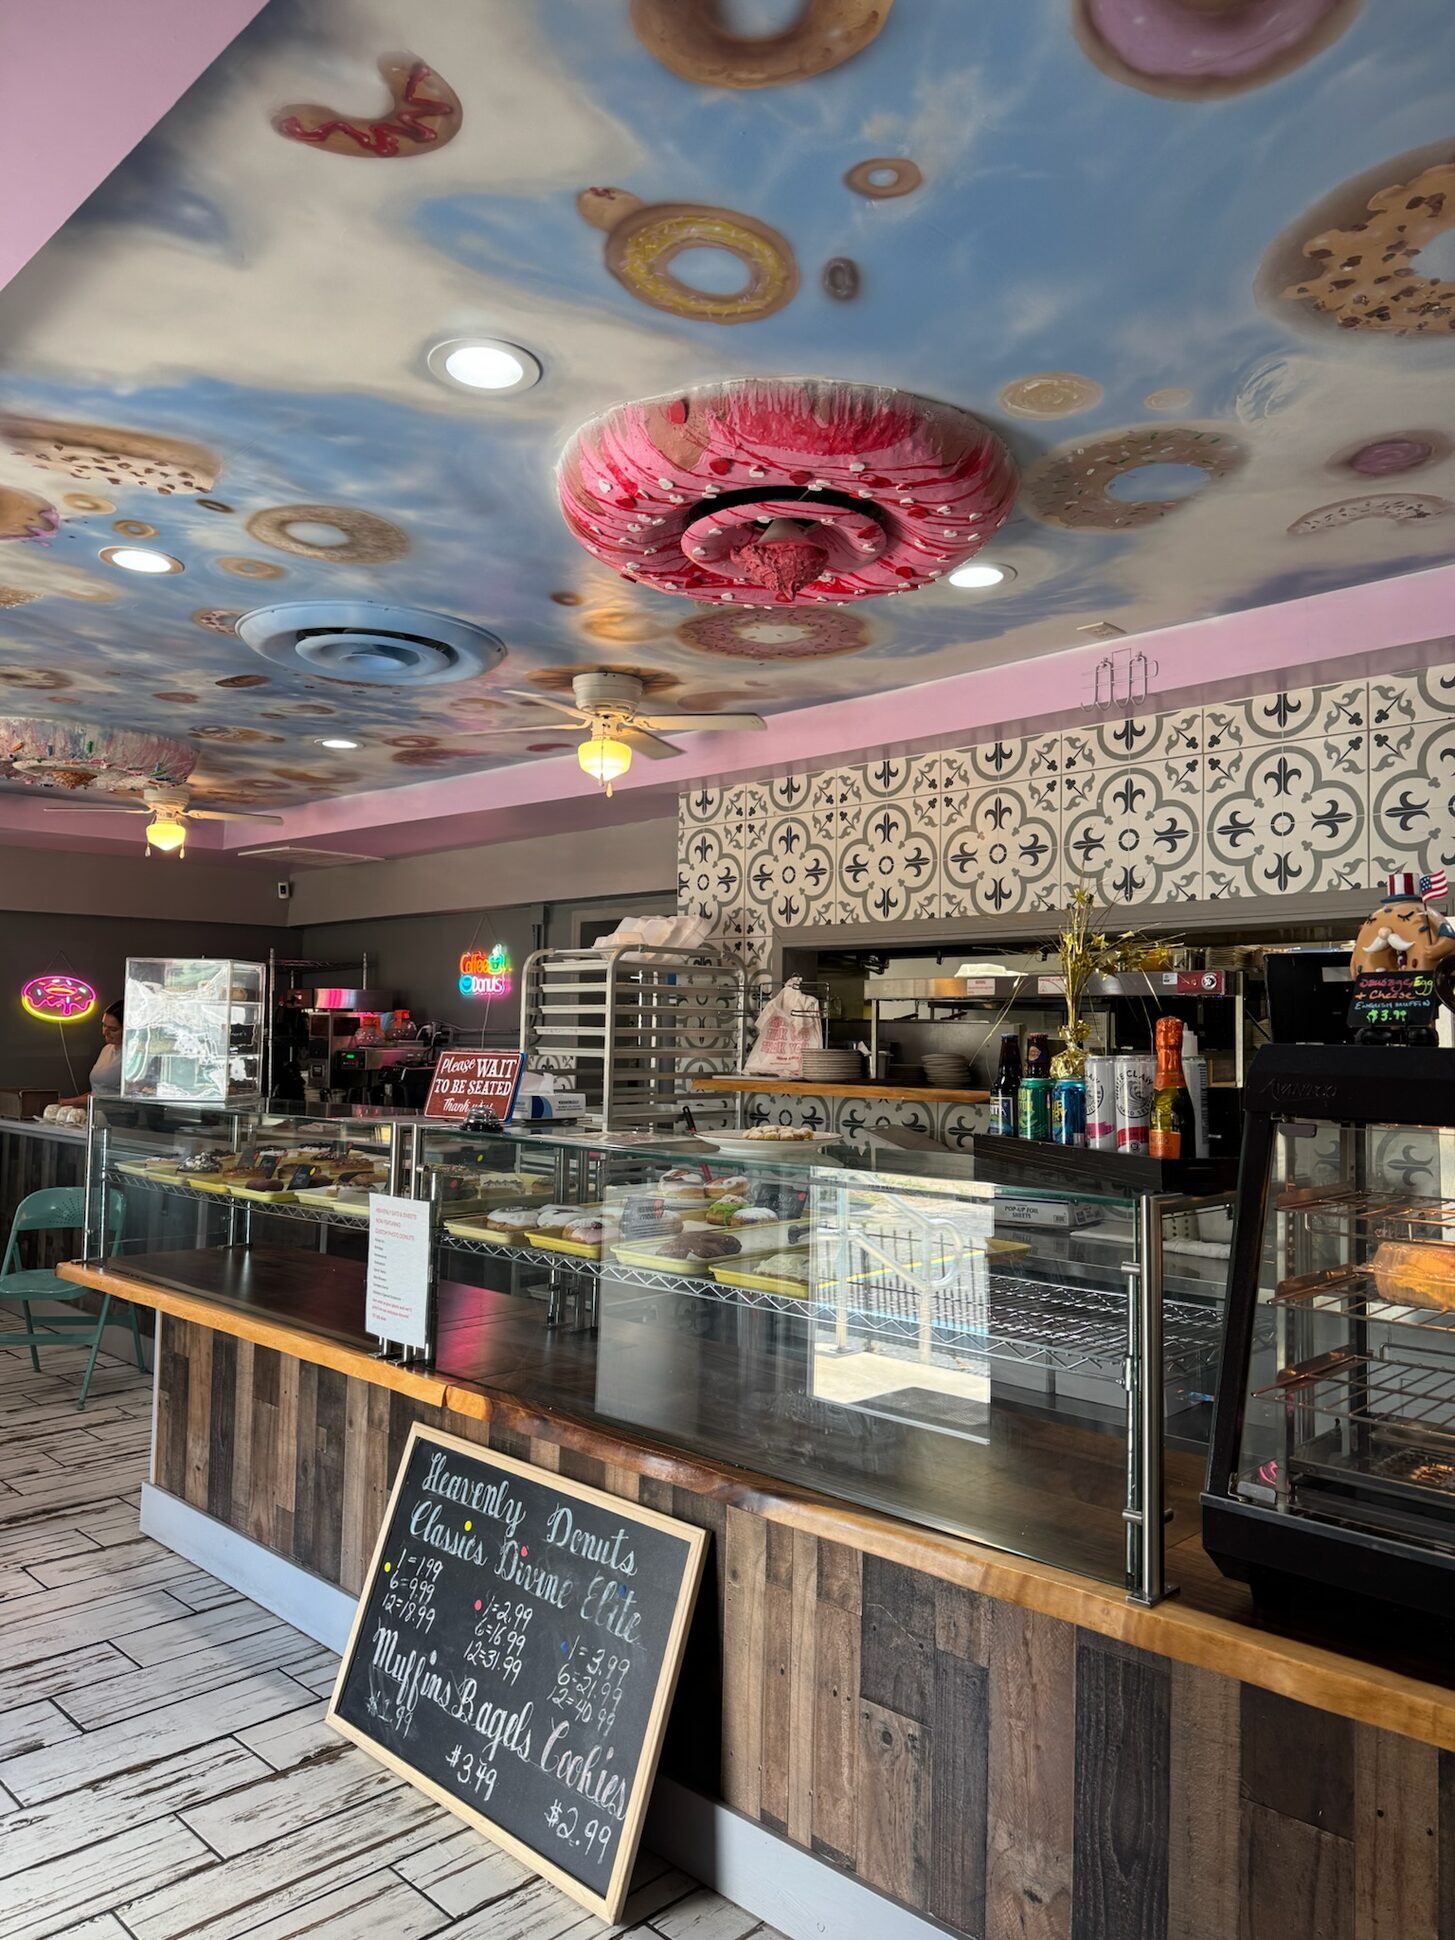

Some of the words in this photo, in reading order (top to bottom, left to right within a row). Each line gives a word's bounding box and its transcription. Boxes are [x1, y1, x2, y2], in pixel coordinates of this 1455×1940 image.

[1413, 976, 1434, 996] Egg
[440, 1056, 477, 1075] Please
[476, 1058, 518, 1079] WAIT
[1126, 1069, 1154, 1086] CLAW
[434, 1078, 450, 1094] TO
[450, 1079, 467, 1094] BE
[467, 1080, 512, 1096] SEATED
[442, 1097, 471, 1113] Thank
[421, 1451, 527, 1538] Heavenly
[546, 1502, 638, 1577] Donuts
[494, 1536, 574, 1610] Divine
[580, 1570, 643, 1644] Elite
[372, 1617, 451, 1713] Muffins
[451, 1673, 535, 1763] Bagels
[540, 1718, 627, 1821] Cookies
[544, 1798, 612, 1865] $2.99
